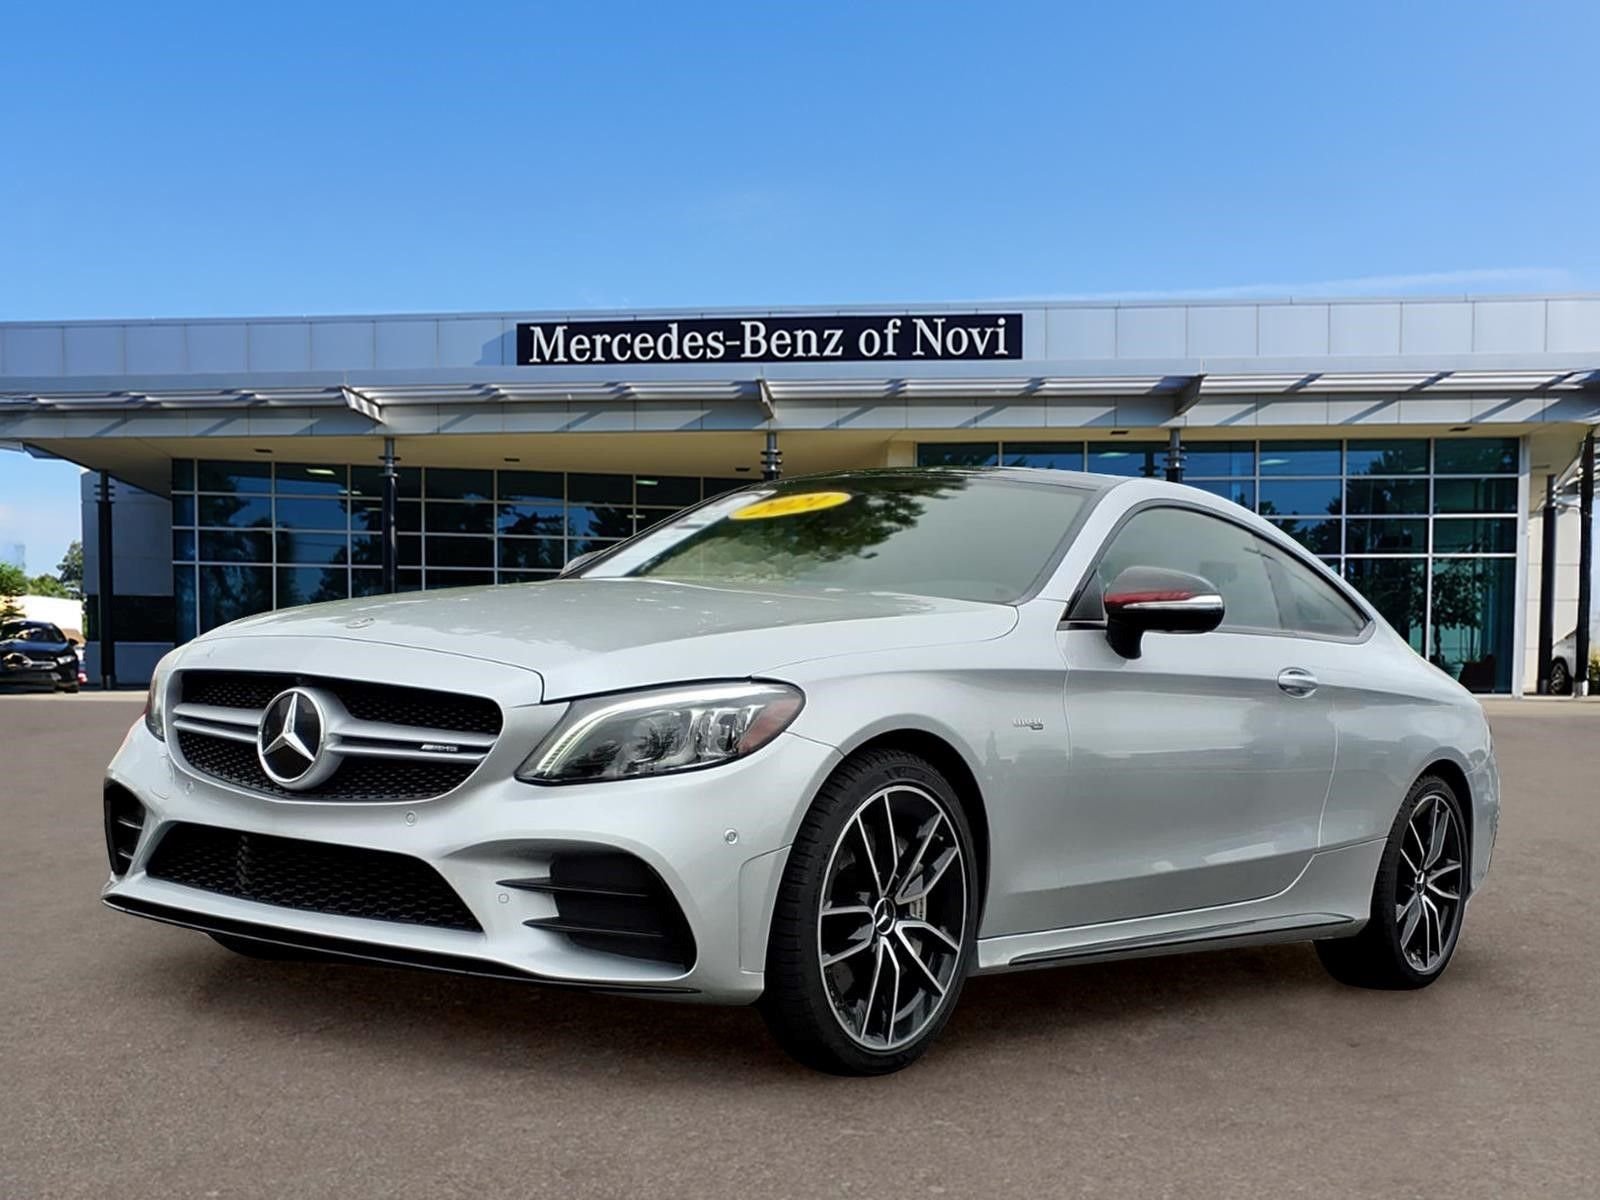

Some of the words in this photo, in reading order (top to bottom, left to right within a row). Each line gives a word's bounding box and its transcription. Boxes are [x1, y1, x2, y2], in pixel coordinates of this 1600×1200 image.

[529, 320, 844, 363] Mercedes-Benz
[858, 318, 902, 356] of
[912, 317, 1009, 356] Novi
